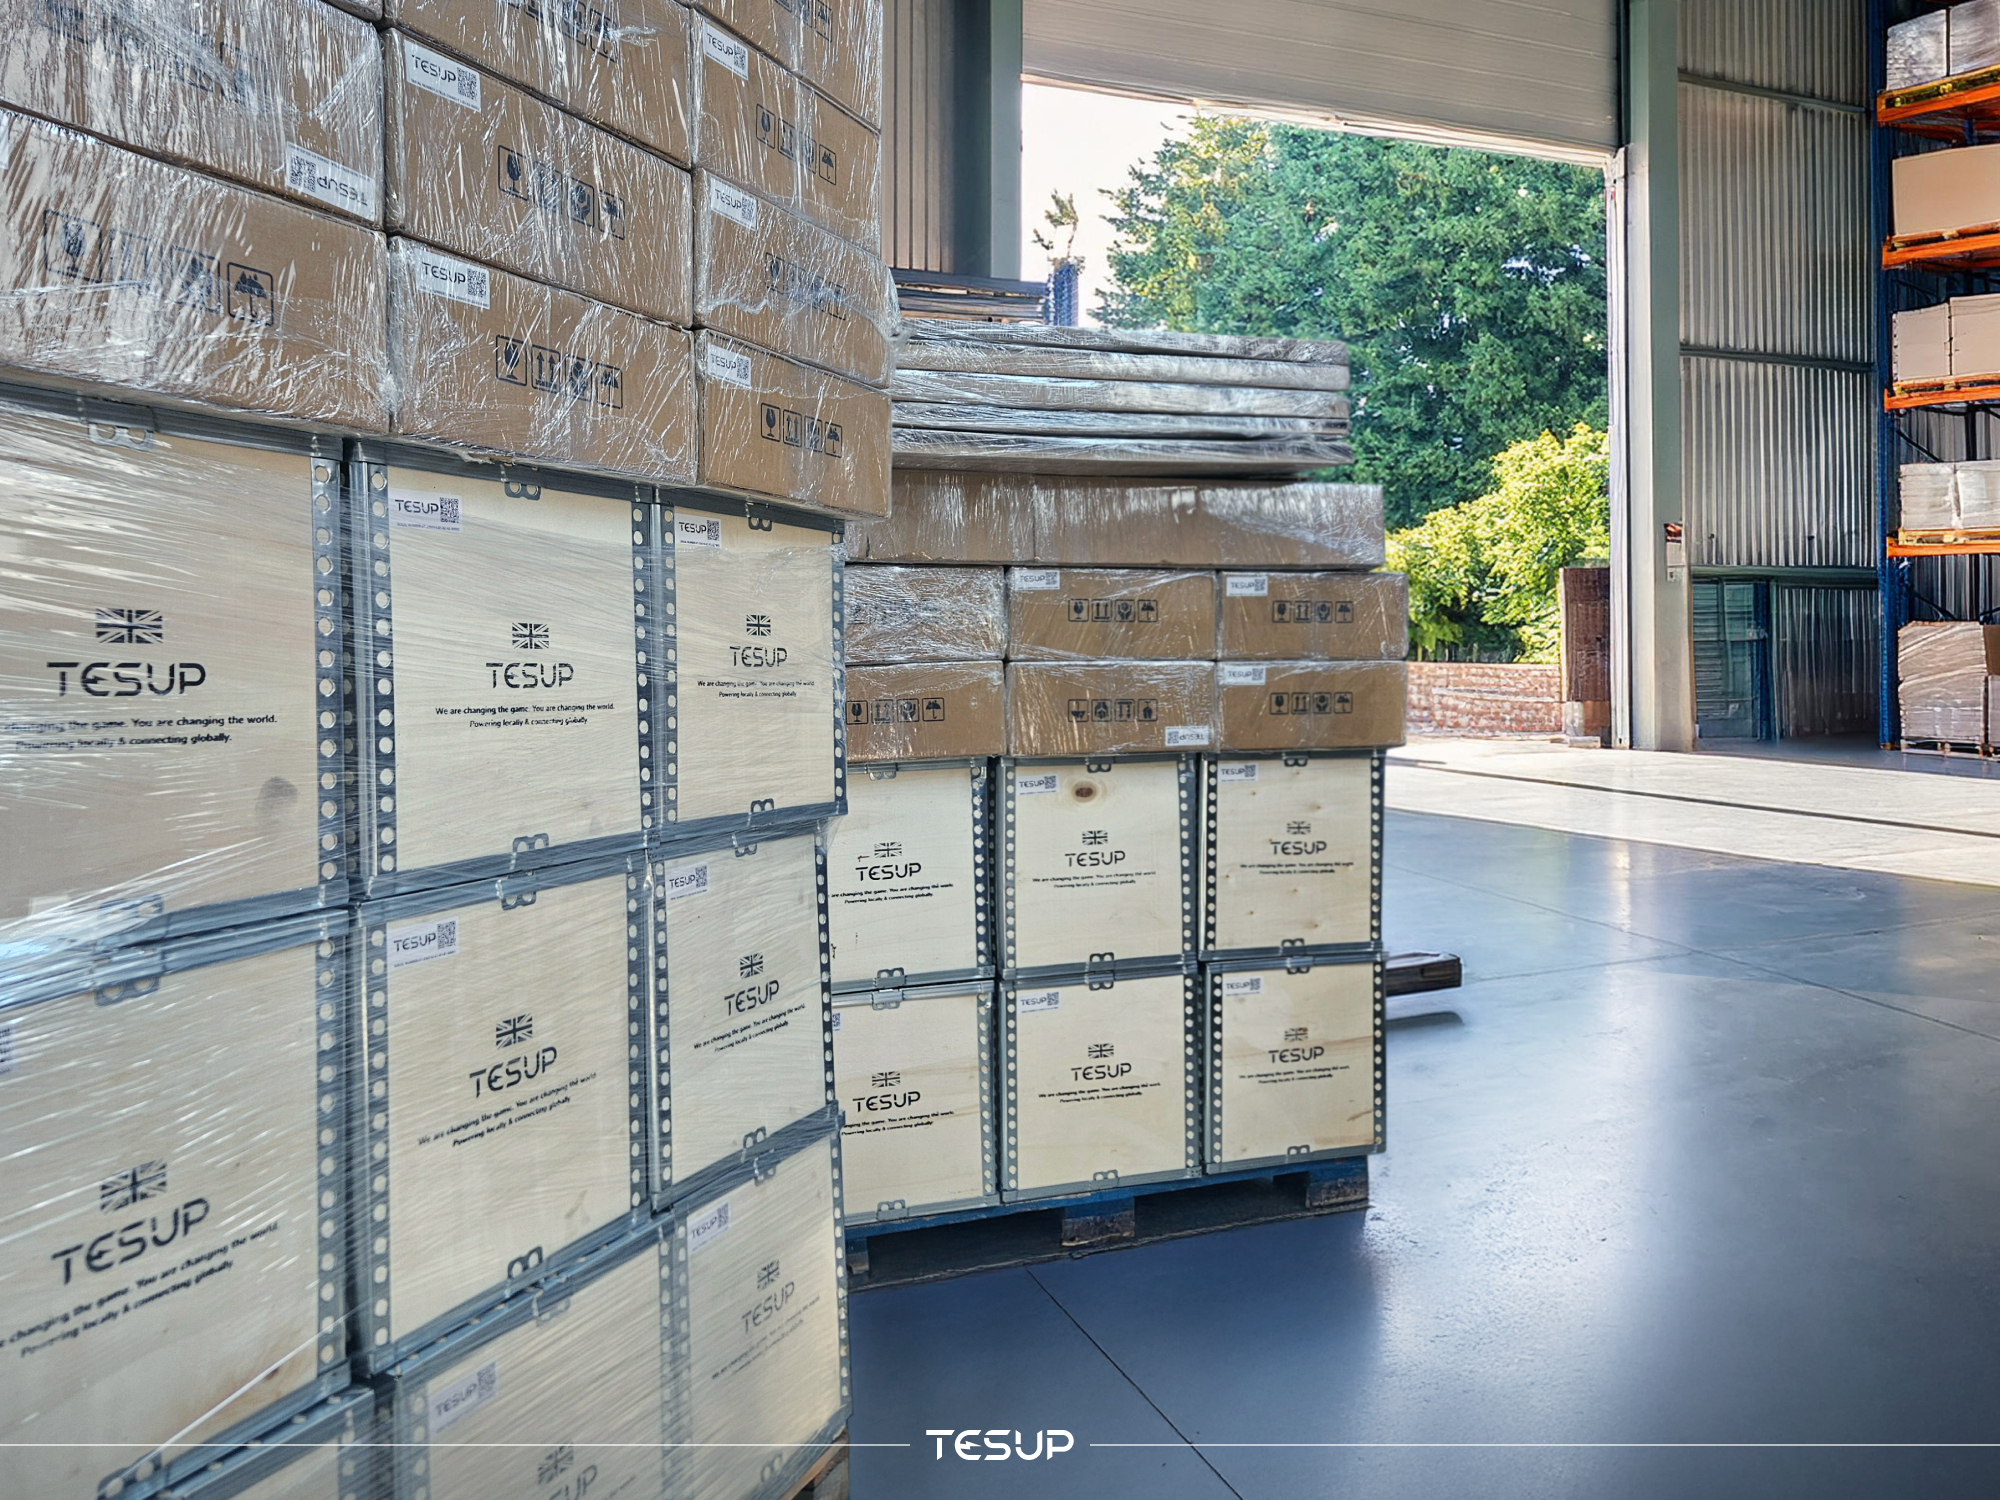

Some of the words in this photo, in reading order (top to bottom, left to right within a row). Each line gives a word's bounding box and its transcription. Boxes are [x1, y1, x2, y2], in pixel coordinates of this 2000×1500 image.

[707, 33, 734, 56] TESUP
[412, 54, 456, 82] TESUP
[316, 176, 368, 206] TESUP
[715, 188, 742, 209] TESUP
[422, 262, 466, 284] TESUP
[711, 354, 736, 370] TESUP
[394, 499, 439, 514] TESUP
[678, 522, 706, 534] TESUP
[1020, 574, 1045, 582] TESUP
[730, 646, 788, 667] TESUP
[46, 662, 206, 697] TESUP
[486, 662, 574, 688] TESUP
[175, 716, 225, 727] changing
[227, 715, 244, 724] the
[1019, 780, 1044, 788] TESUP
[1064, 850, 1126, 867] TESUP
[1270, 841, 1327, 855] TESUP
[669, 874, 696, 889] TESUP
[855, 862, 922, 881] TESUP
[394, 932, 436, 952] TESUP
[724, 980, 779, 1016] TESUP
[1020, 996, 1046, 1006] TESUP
[1268, 1046, 1324, 1063] TESUP
[469, 1046, 557, 1098] TESUP
[1071, 1063, 1132, 1081] TESUP
[852, 1091, 920, 1112] TESUP
[691, 1216, 718, 1238] TESUP
[51, 1198, 210, 1285] TESUP
[741, 1282, 795, 1334] TESUP
[434, 1383, 478, 1416] TESUP
